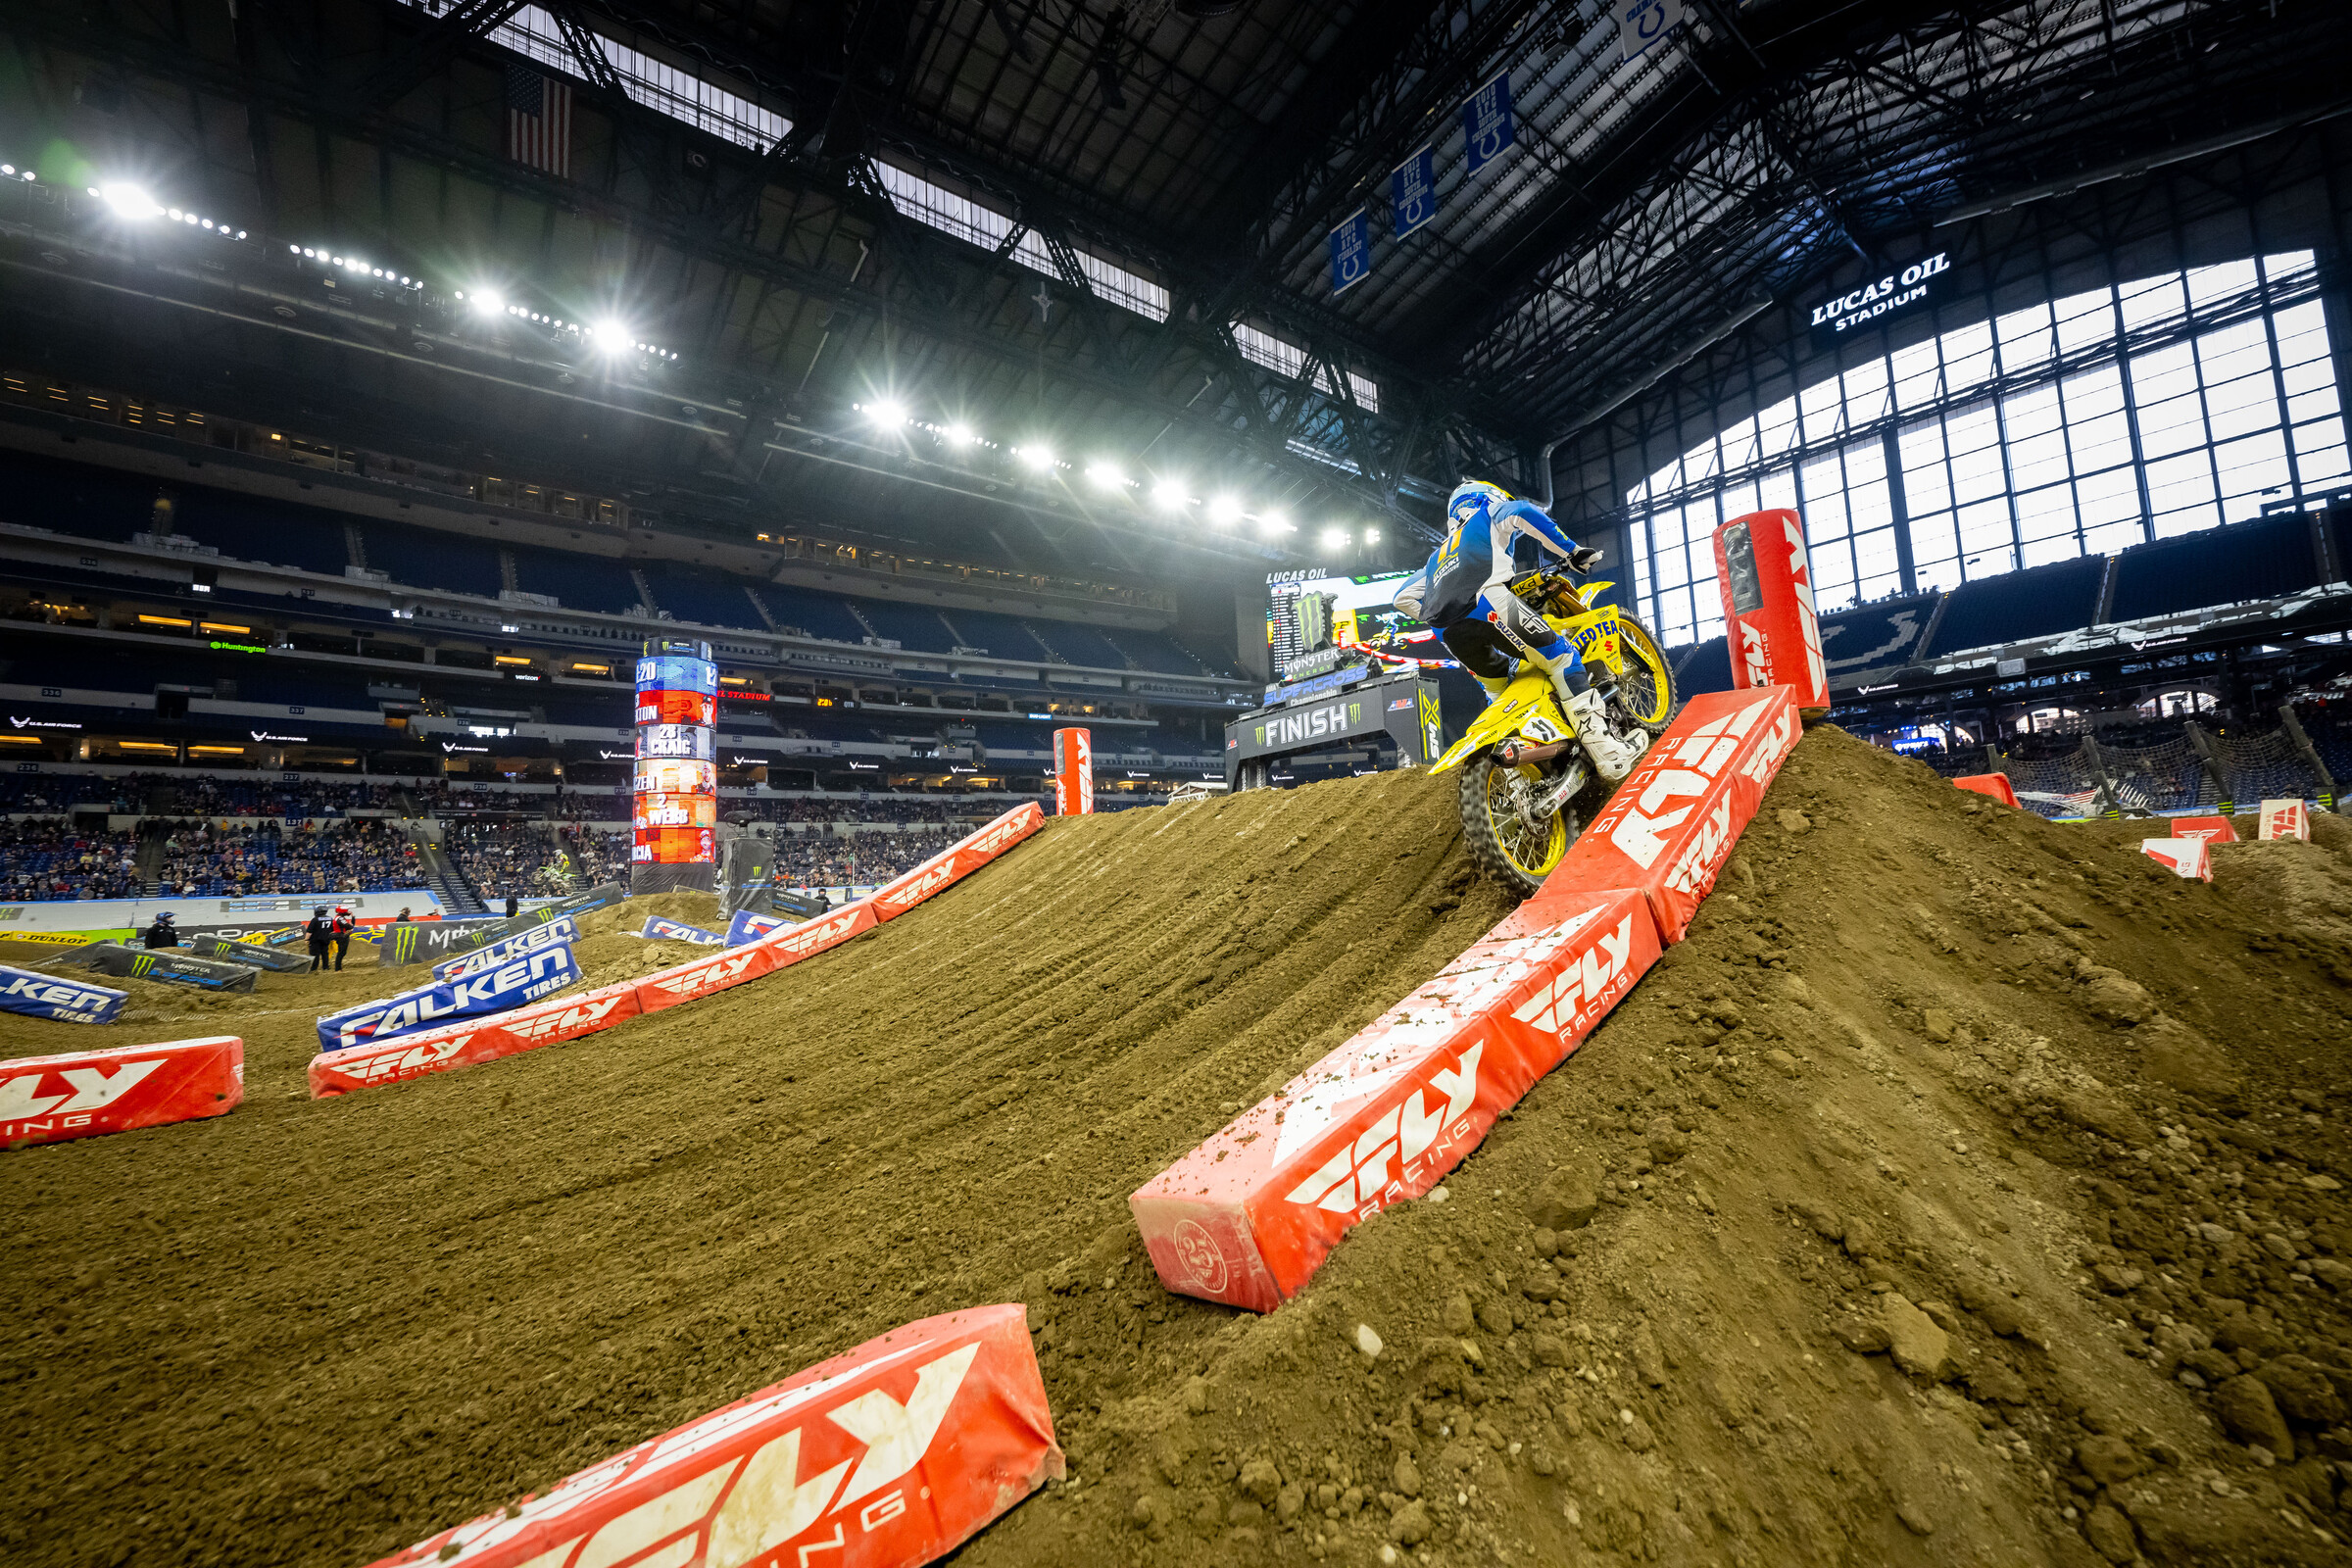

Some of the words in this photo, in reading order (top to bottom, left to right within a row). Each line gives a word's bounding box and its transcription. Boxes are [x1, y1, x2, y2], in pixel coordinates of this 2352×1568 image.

[1811, 275, 1894, 326] LUCAS
[1900, 252, 1950, 286] OIL
[1836, 284, 1928, 332] STADIUM
[1266, 569, 1305, 585] LUCAS
[1307, 567, 1328, 580] OIL
[222, 643, 266, 653] Huntington
[1495, 620, 1527, 651] SUZUKI
[1571, 628, 1597, 649] TED
[1594, 620, 1619, 637] TEA
[1263, 665, 1368, 706] SUPERCROSS
[1293, 663, 1332, 680] ENERGY
[728, 691, 770, 702] STADIUM
[1290, 689, 1338, 708] Championship
[660, 724, 676, 739] 28
[1265, 703, 1348, 748] FINISH
[1740, 702, 1791, 783] FLY
[651, 739, 691, 756] CRAIG
[656, 794, 667, 809] 2
[1593, 736, 1683, 834] RACING
[1610, 696, 1776, 870] FLY
[649, 809, 689, 825] WEBB
[968, 808, 1032, 853] FLY
[1663, 788, 1732, 894] FLY
[885, 857, 956, 905] FLY
[907, 874, 954, 907] RACING
[27, 935, 87, 944] DUNLOP
[321, 920, 331, 929] 17
[773, 909, 861, 953] FLY
[798, 931, 849, 956] RACING
[443, 918, 572, 977] FALKEN
[523, 972, 571, 1001] TIRES
[655, 953, 757, 994] FLY
[681, 974, 742, 998] RACING
[1509, 911, 1633, 1033] FLY
[51, 1007, 96, 1023] TIRES
[335, 948, 568, 1047] FALKEN
[500, 996, 622, 1038] FLY
[1559, 975, 1629, 1045] RACING
[531, 1019, 601, 1043] RACING
[330, 1034, 474, 1079] FLY
[0, 1058, 170, 1121] LY
[1284, 1038, 1484, 1214] FLY
[1358, 1117, 1473, 1223] RACING
